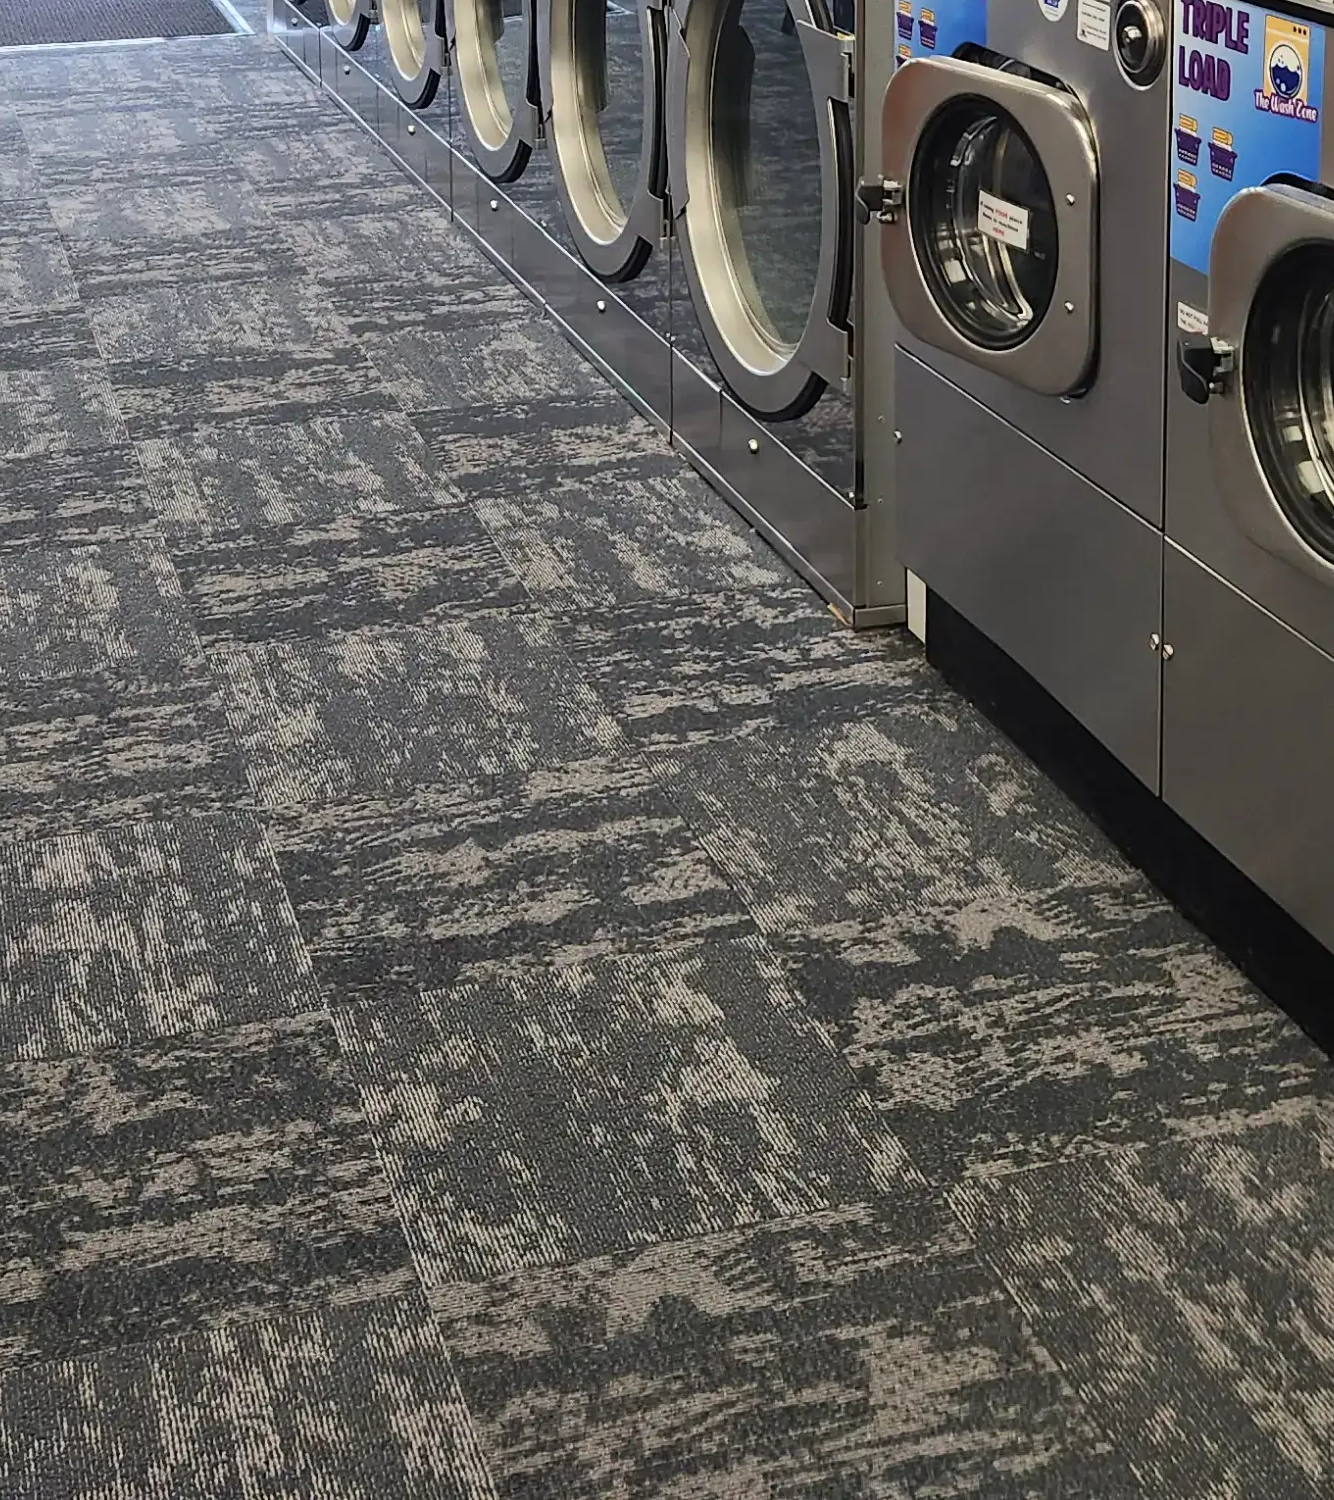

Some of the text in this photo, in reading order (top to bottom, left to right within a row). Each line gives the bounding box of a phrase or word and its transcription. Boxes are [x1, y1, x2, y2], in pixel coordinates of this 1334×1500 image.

[1178, 45, 1231, 102] LOAD
[1254, 90, 1318, 122] The Wash Zone
